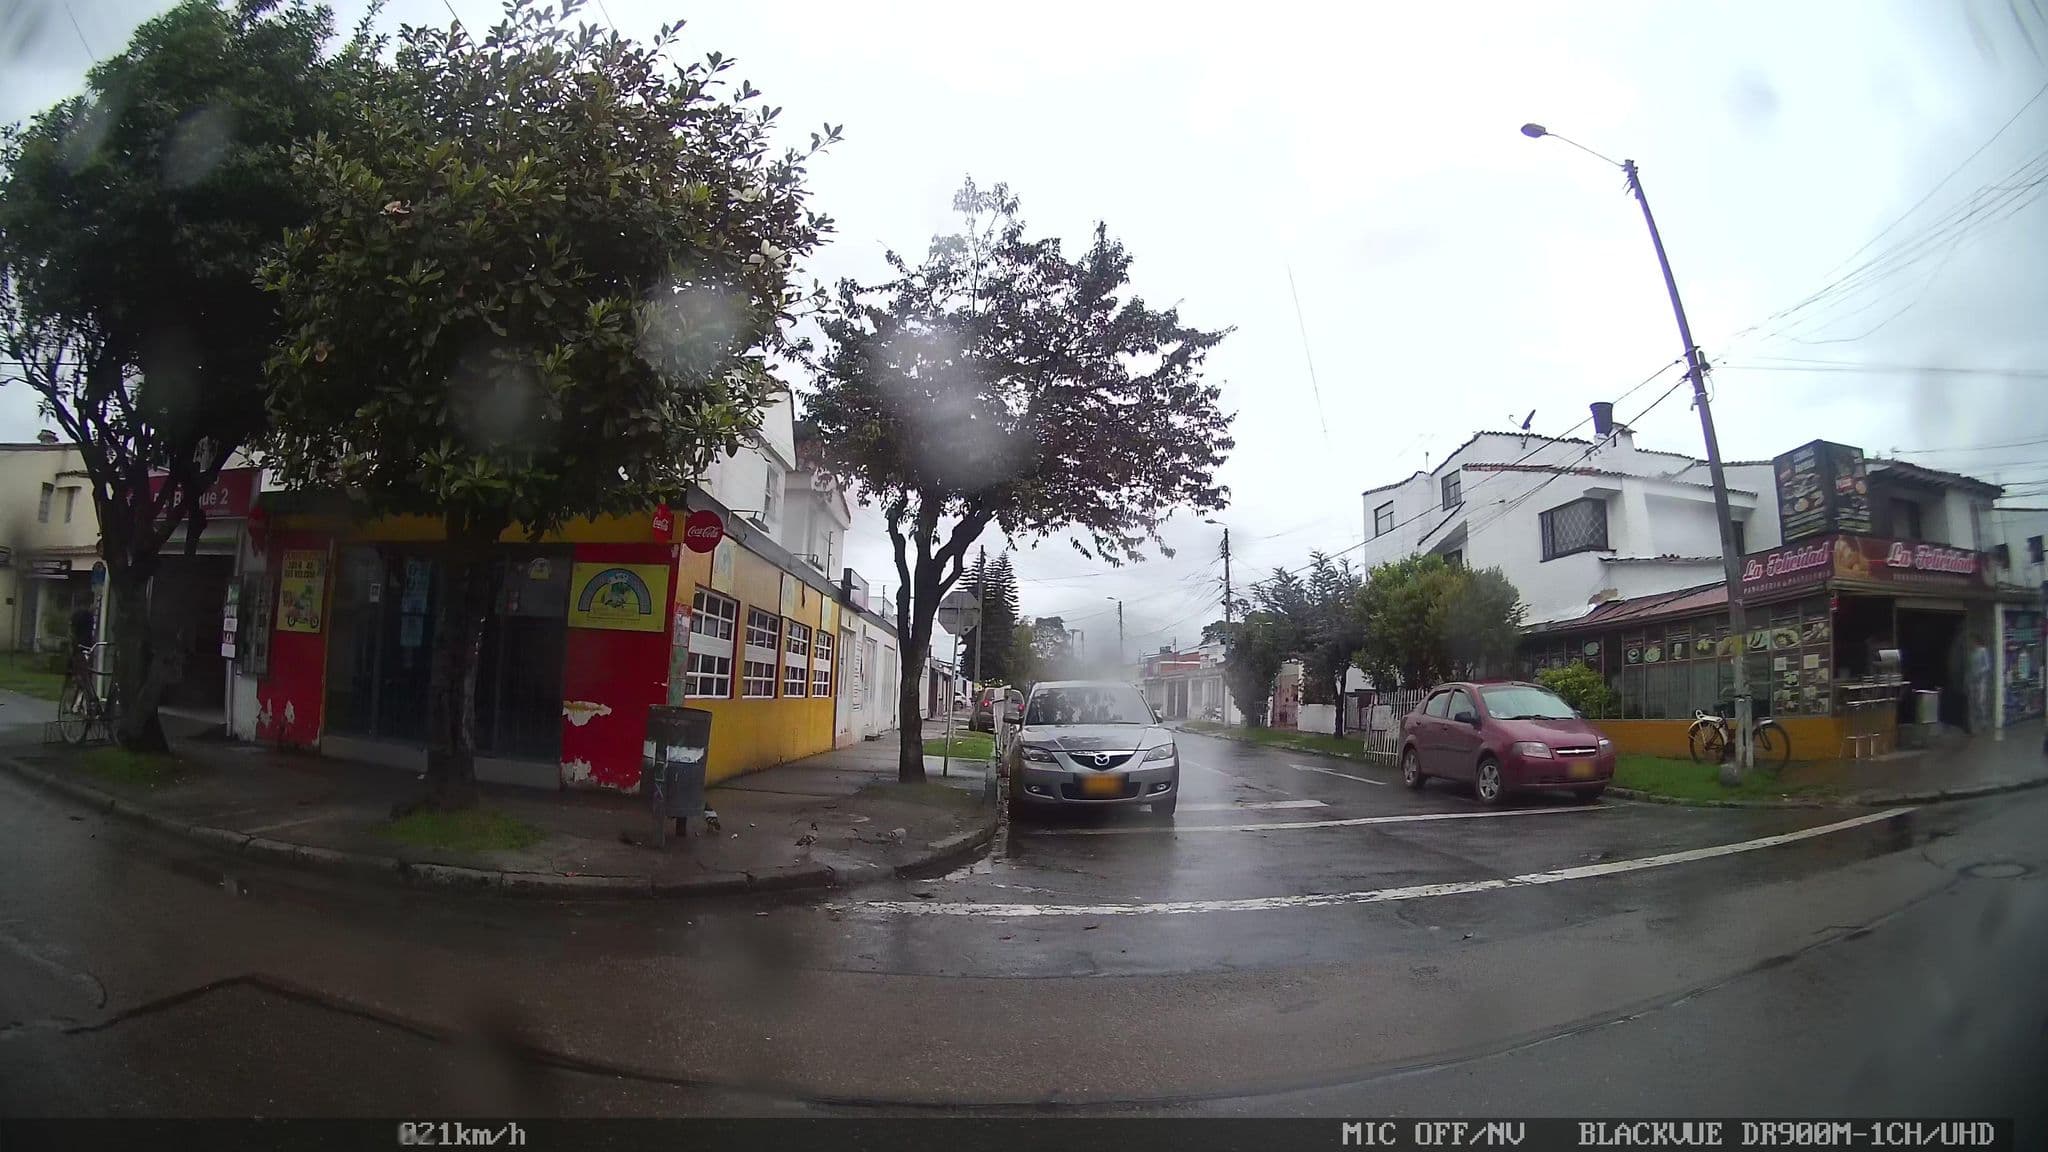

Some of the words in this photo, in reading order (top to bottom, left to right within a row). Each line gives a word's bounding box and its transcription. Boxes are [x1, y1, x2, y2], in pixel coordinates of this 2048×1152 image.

[219, 487, 229, 505] 2
[688, 525, 719, 538] Coca-Cola
[1743, 559, 1763, 582] La
[1766, 541, 1829, 576] Felicidad
[1887, 541, 1912, 567] La
[1916, 544, 1976, 574] Felicidad
